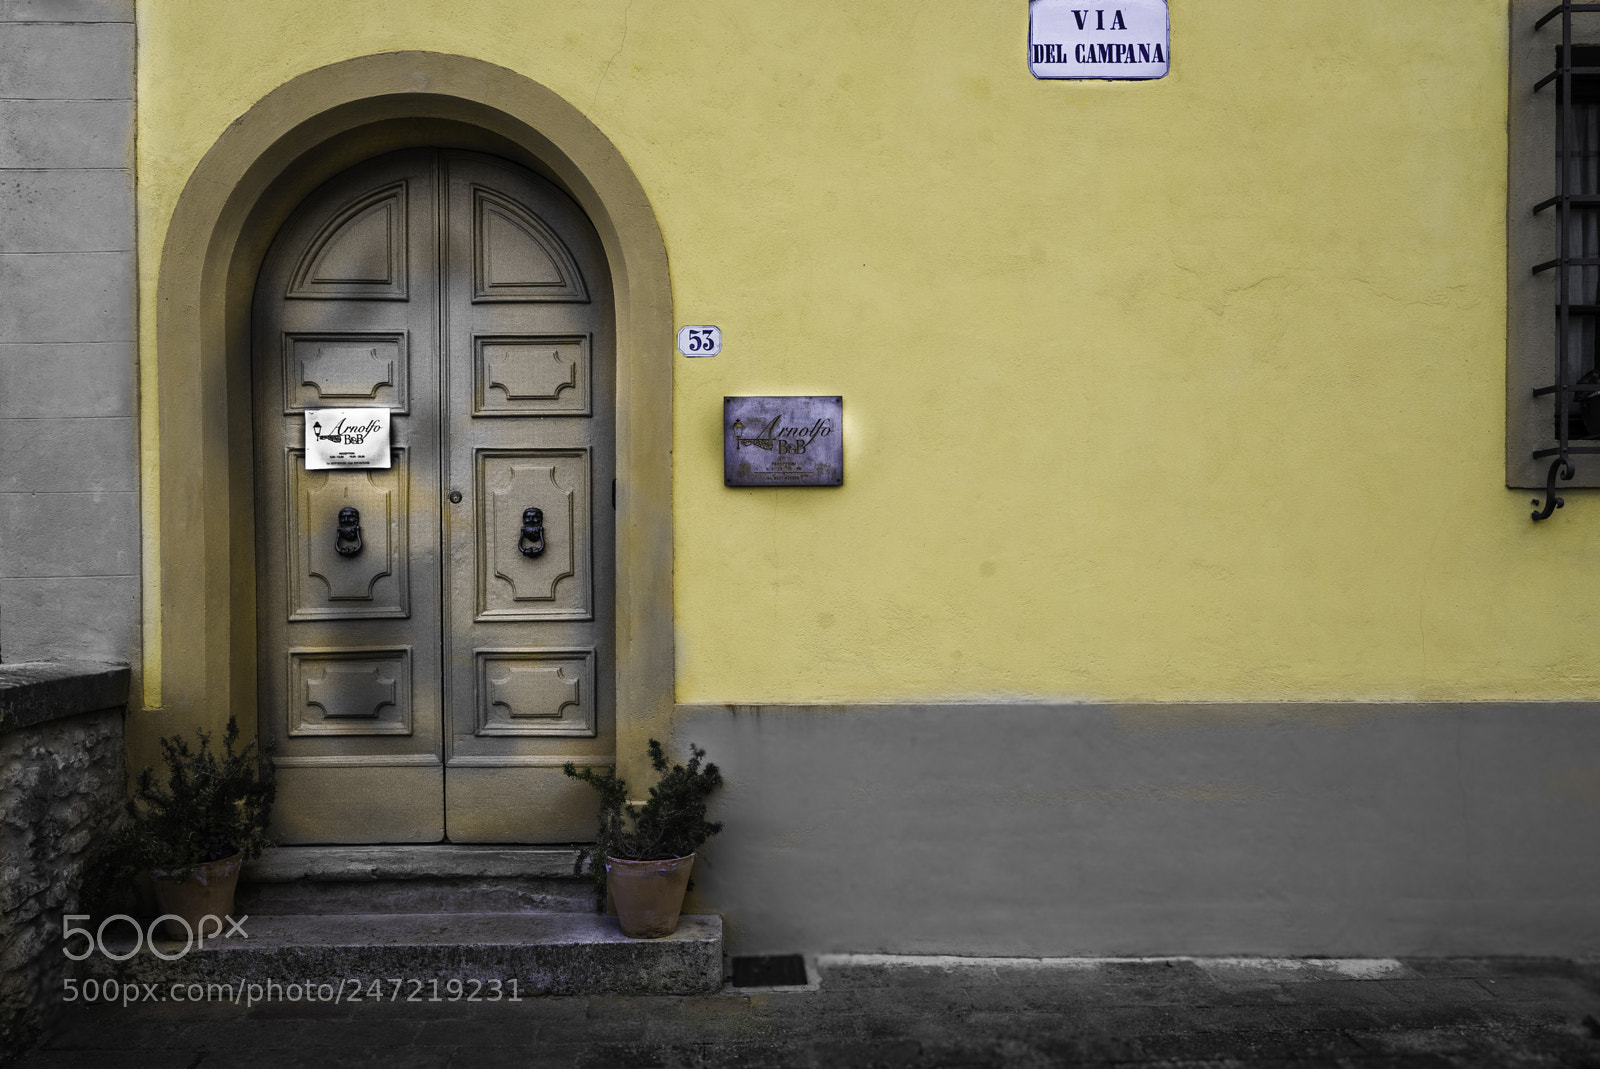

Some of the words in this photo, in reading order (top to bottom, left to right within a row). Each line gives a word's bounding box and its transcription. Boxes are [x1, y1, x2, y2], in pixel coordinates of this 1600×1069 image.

[1071, 9, 1127, 31] VIA
[1032, 43, 1067, 64] DEL
[1075, 43, 1166, 64] CAMPANA
[689, 329, 715, 351] 53
[329, 417, 382, 440] Arnolfo
[344, 433, 364, 445] B&B
[756, 414, 833, 448] Arnolfo
[778, 439, 806, 455] B&B
